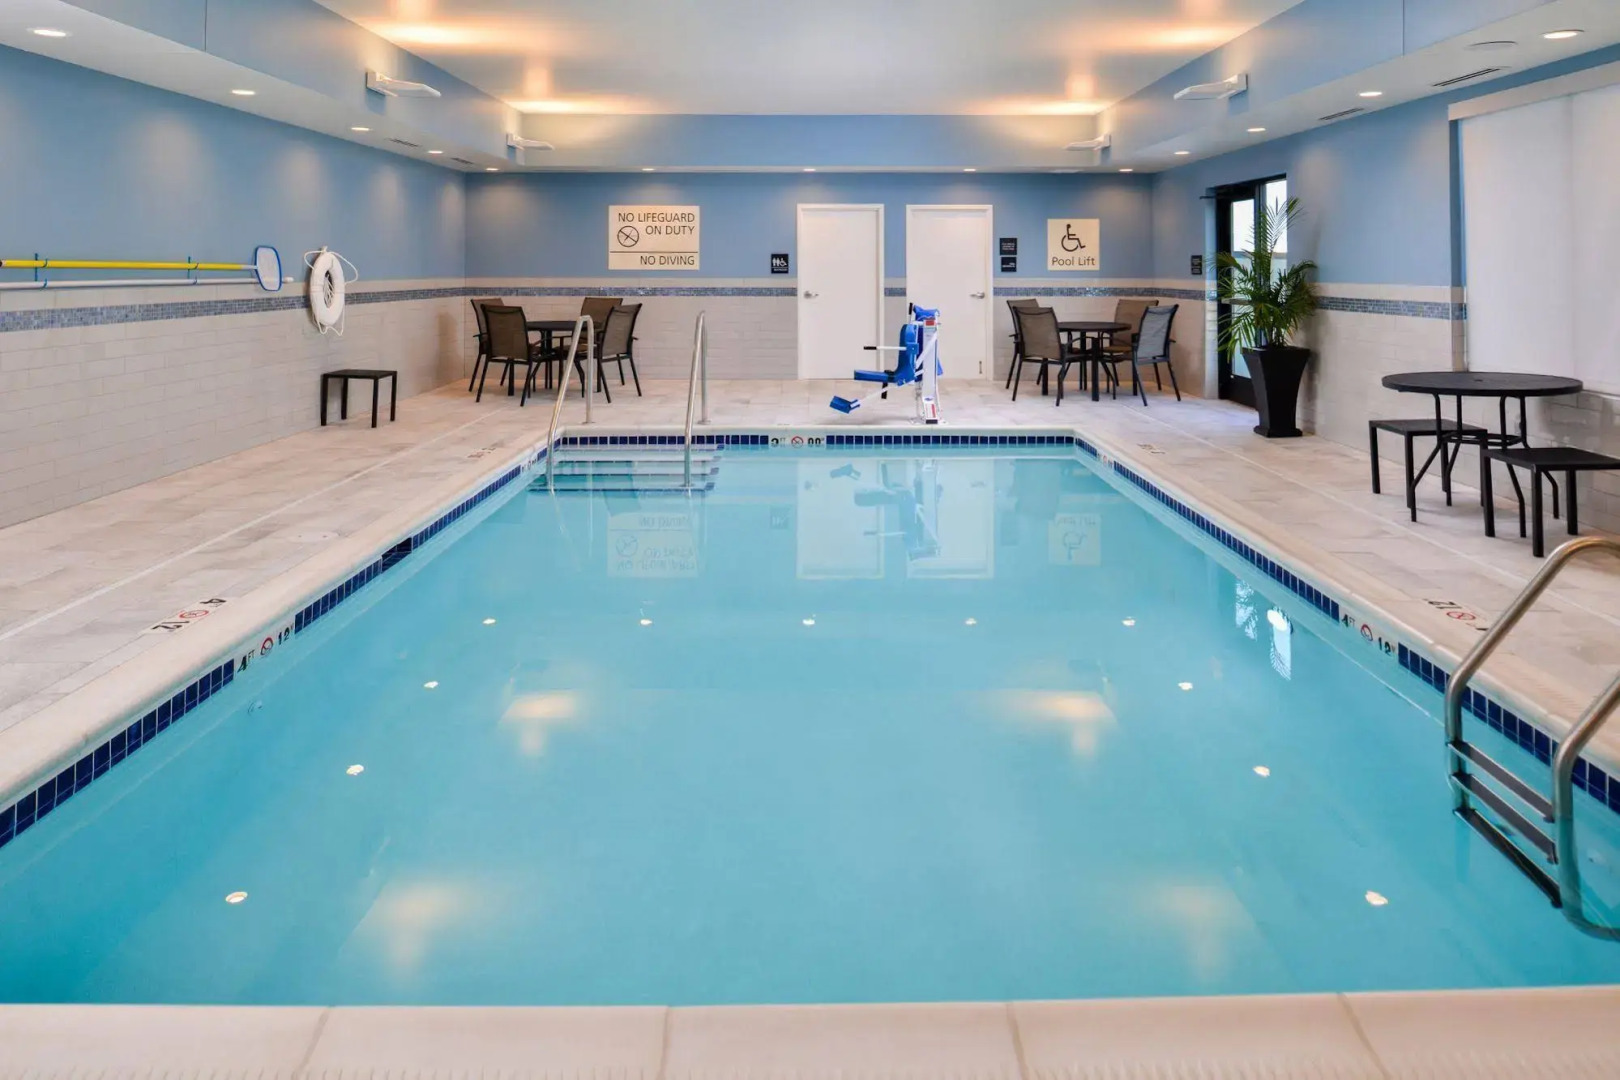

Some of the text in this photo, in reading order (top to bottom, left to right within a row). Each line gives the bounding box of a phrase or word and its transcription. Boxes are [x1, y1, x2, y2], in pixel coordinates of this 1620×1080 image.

[618, 212, 695, 222] NO LIFEGUARD
[646, 226, 695, 235] ON DUTY
[640, 256, 695, 266] NO DIVING
[1052, 256, 1095, 266] Pool Lift
